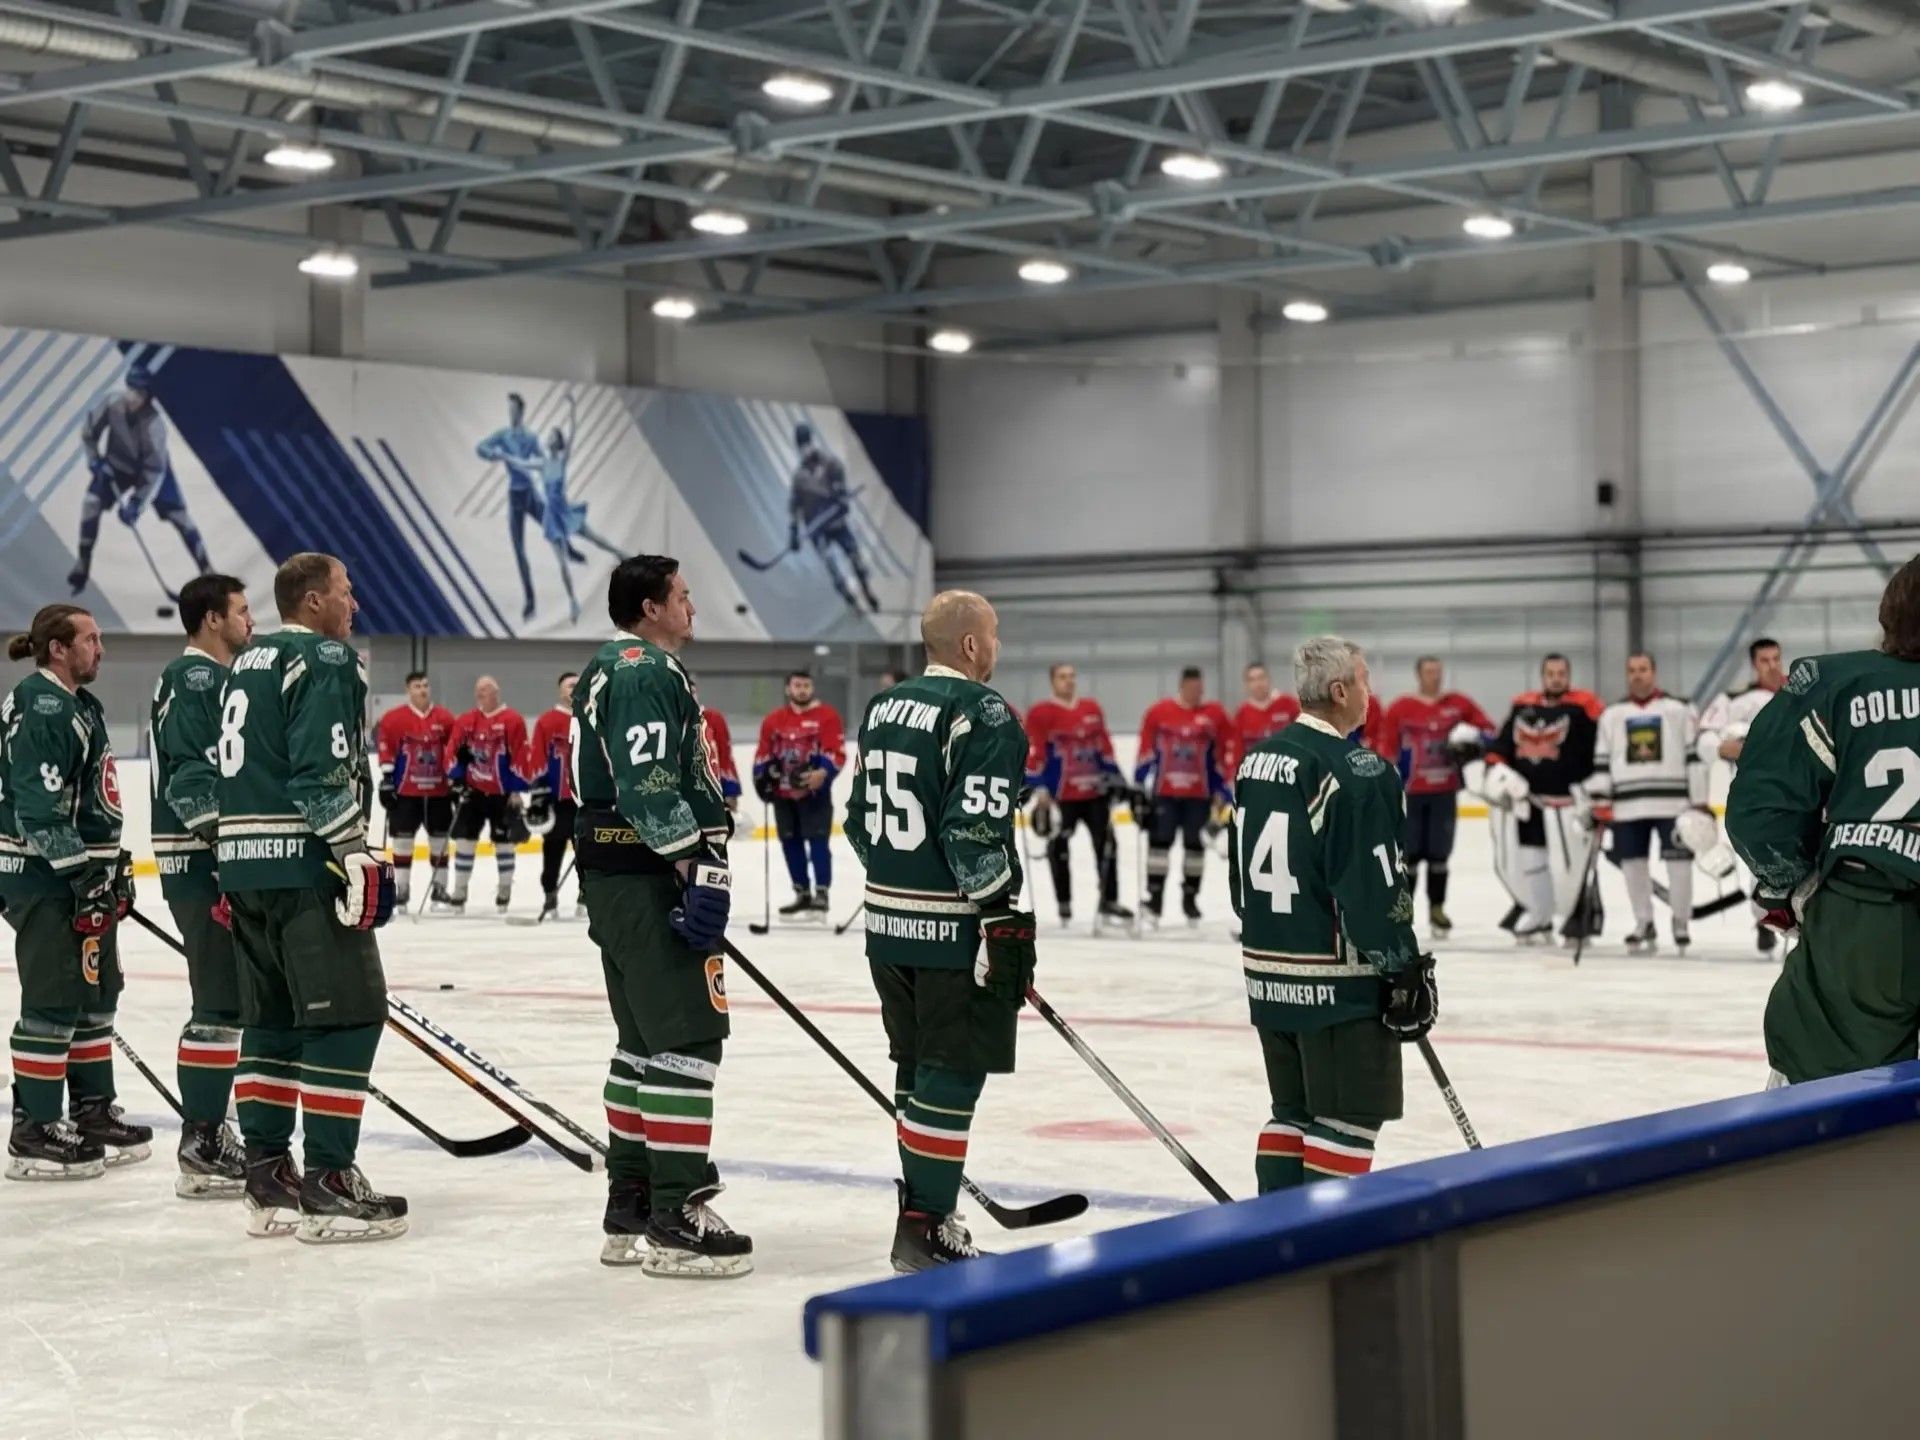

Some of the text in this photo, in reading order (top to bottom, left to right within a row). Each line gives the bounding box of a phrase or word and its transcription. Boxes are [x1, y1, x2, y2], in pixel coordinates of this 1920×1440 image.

[331, 722, 348, 758] 8
[626, 721, 667, 766] 27
[864, 750, 926, 852] 55
[962, 775, 1010, 818] 55
[237, 838, 284, 860] ХОККЕЯ
[286, 838, 306, 858] РТ
[1236, 806, 1300, 914] 14
[887, 915, 937, 941] ХОККЕЯ
[939, 921, 959, 942] РТ
[1265, 981, 1315, 1006] ХОККЕЯ
[1316, 985, 1336, 1006] РТ
